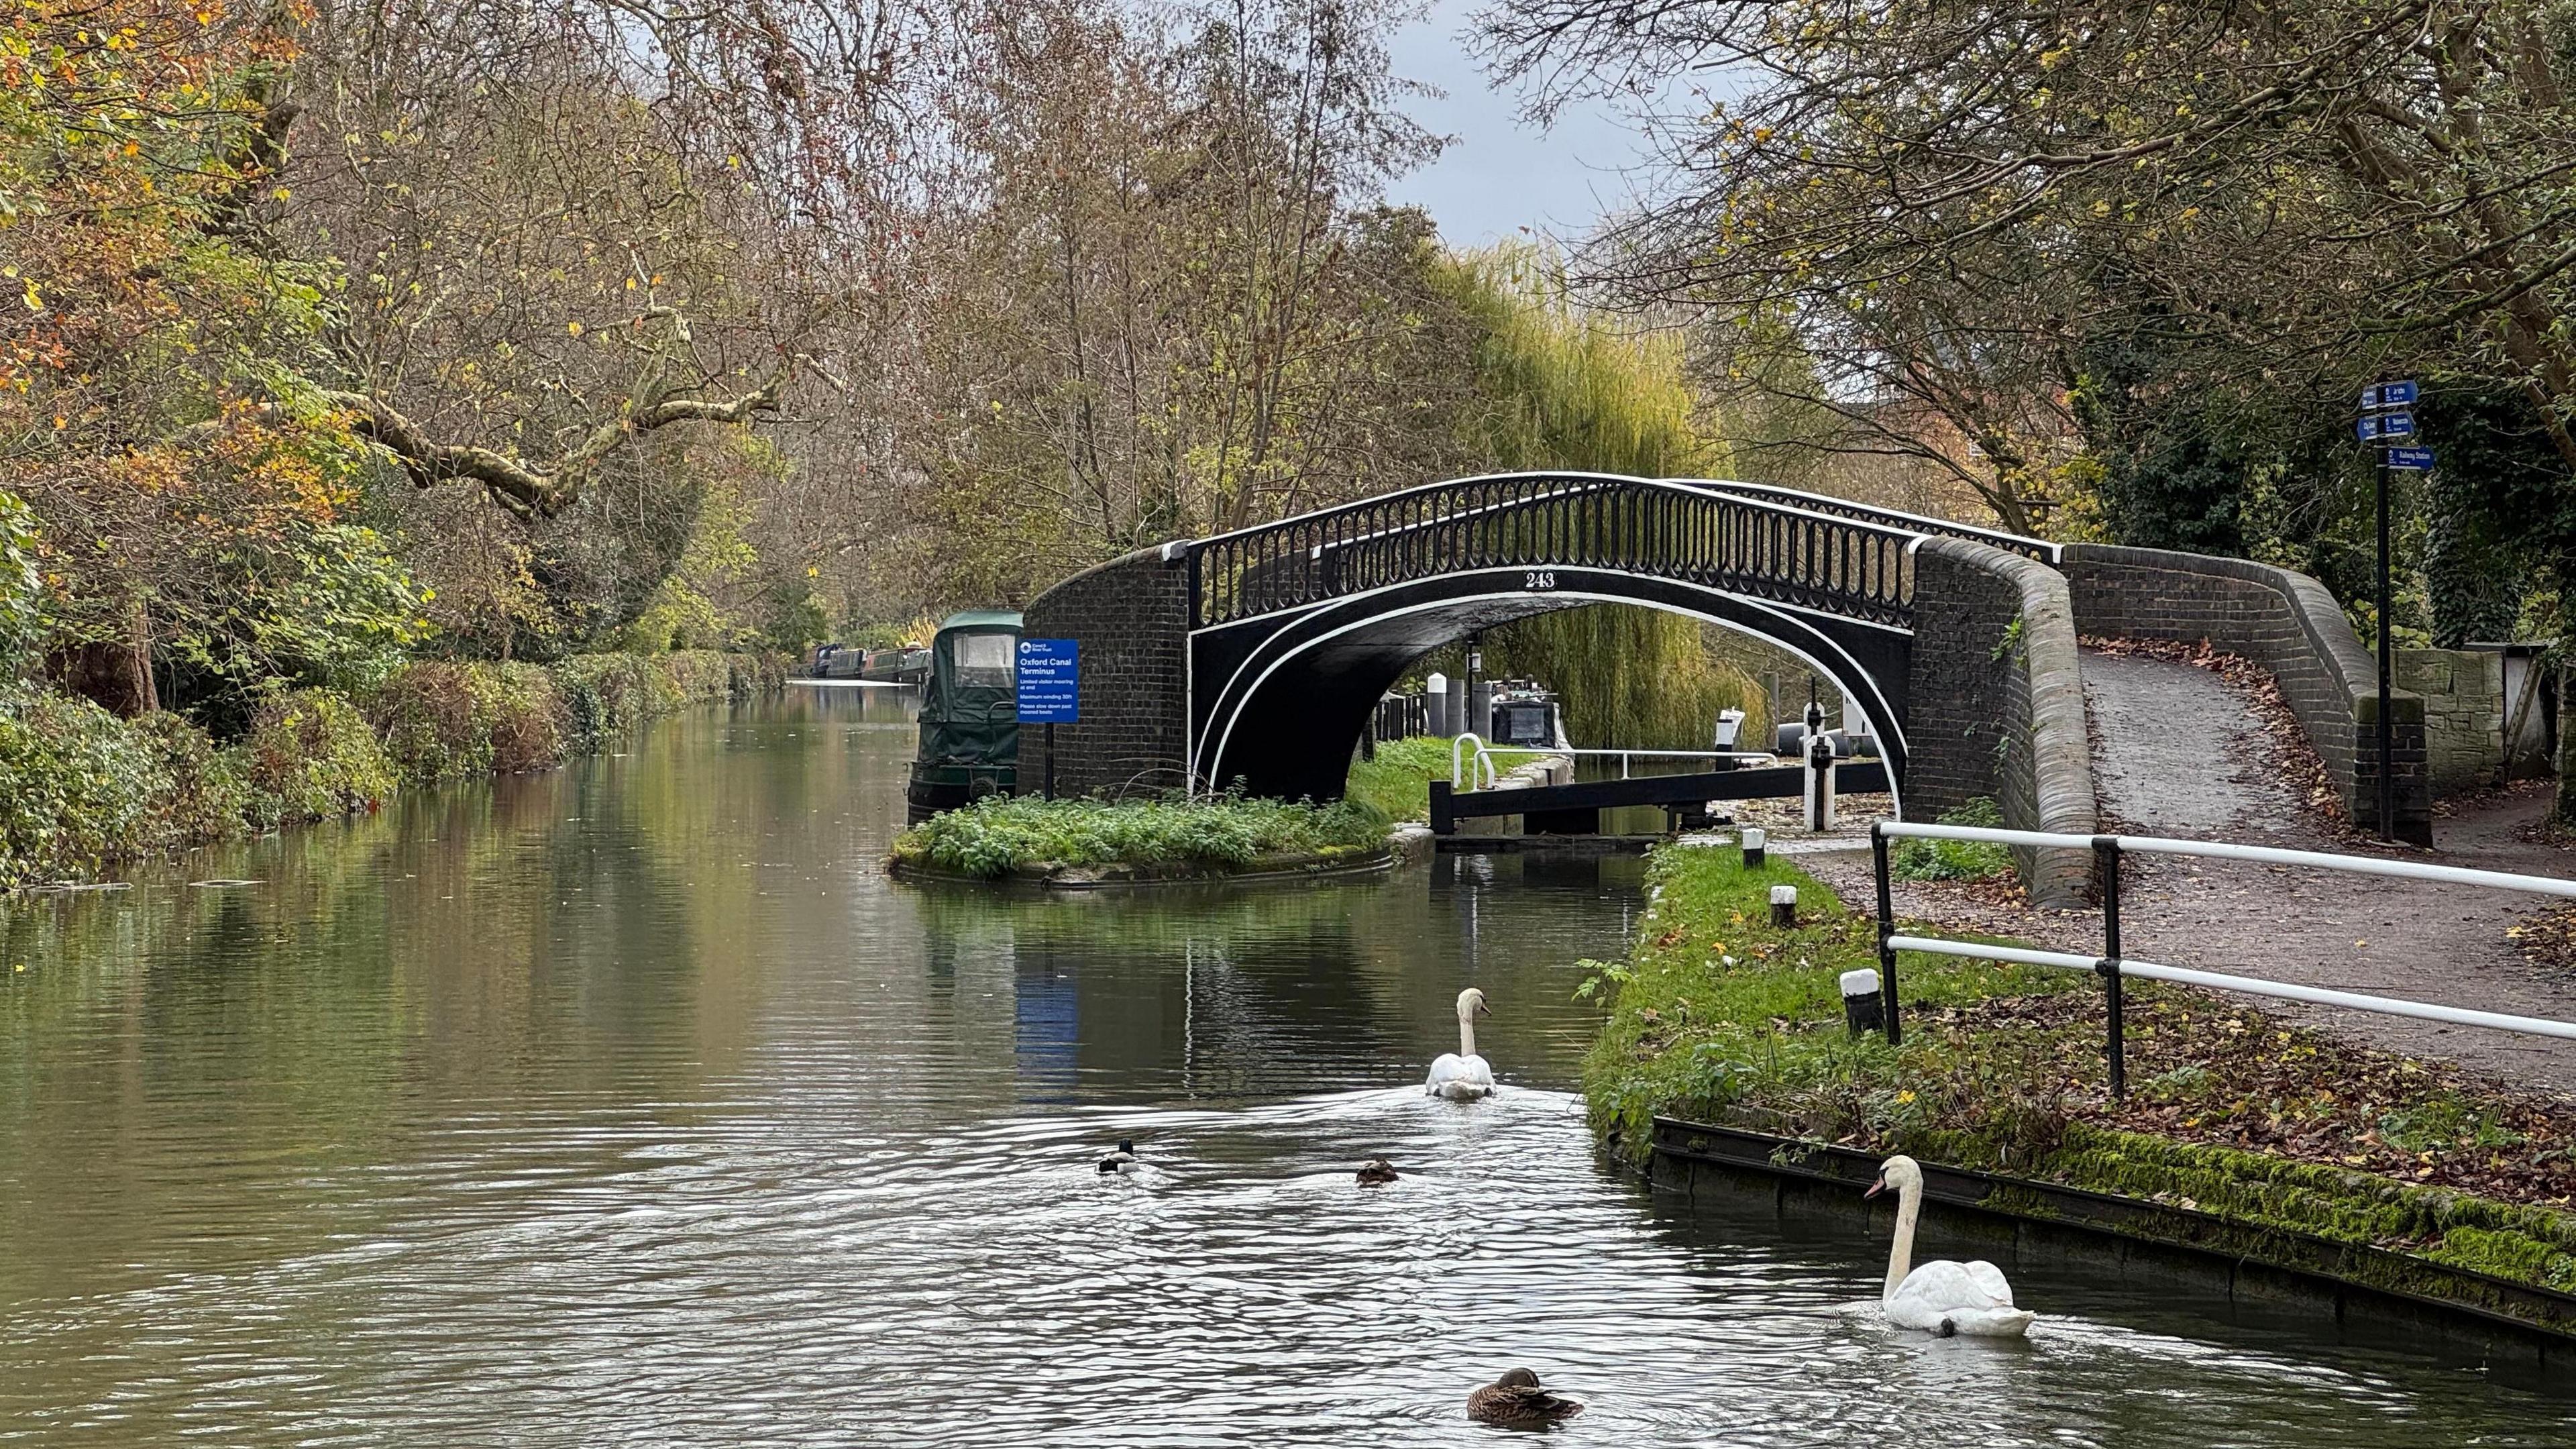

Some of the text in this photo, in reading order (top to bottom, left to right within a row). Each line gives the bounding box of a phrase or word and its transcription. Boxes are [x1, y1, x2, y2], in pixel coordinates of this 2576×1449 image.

[2416, 451, 2430, 460] Station
[1525, 572, 1555, 588] 243
[1020, 658, 1072, 666] Oxford Canal
